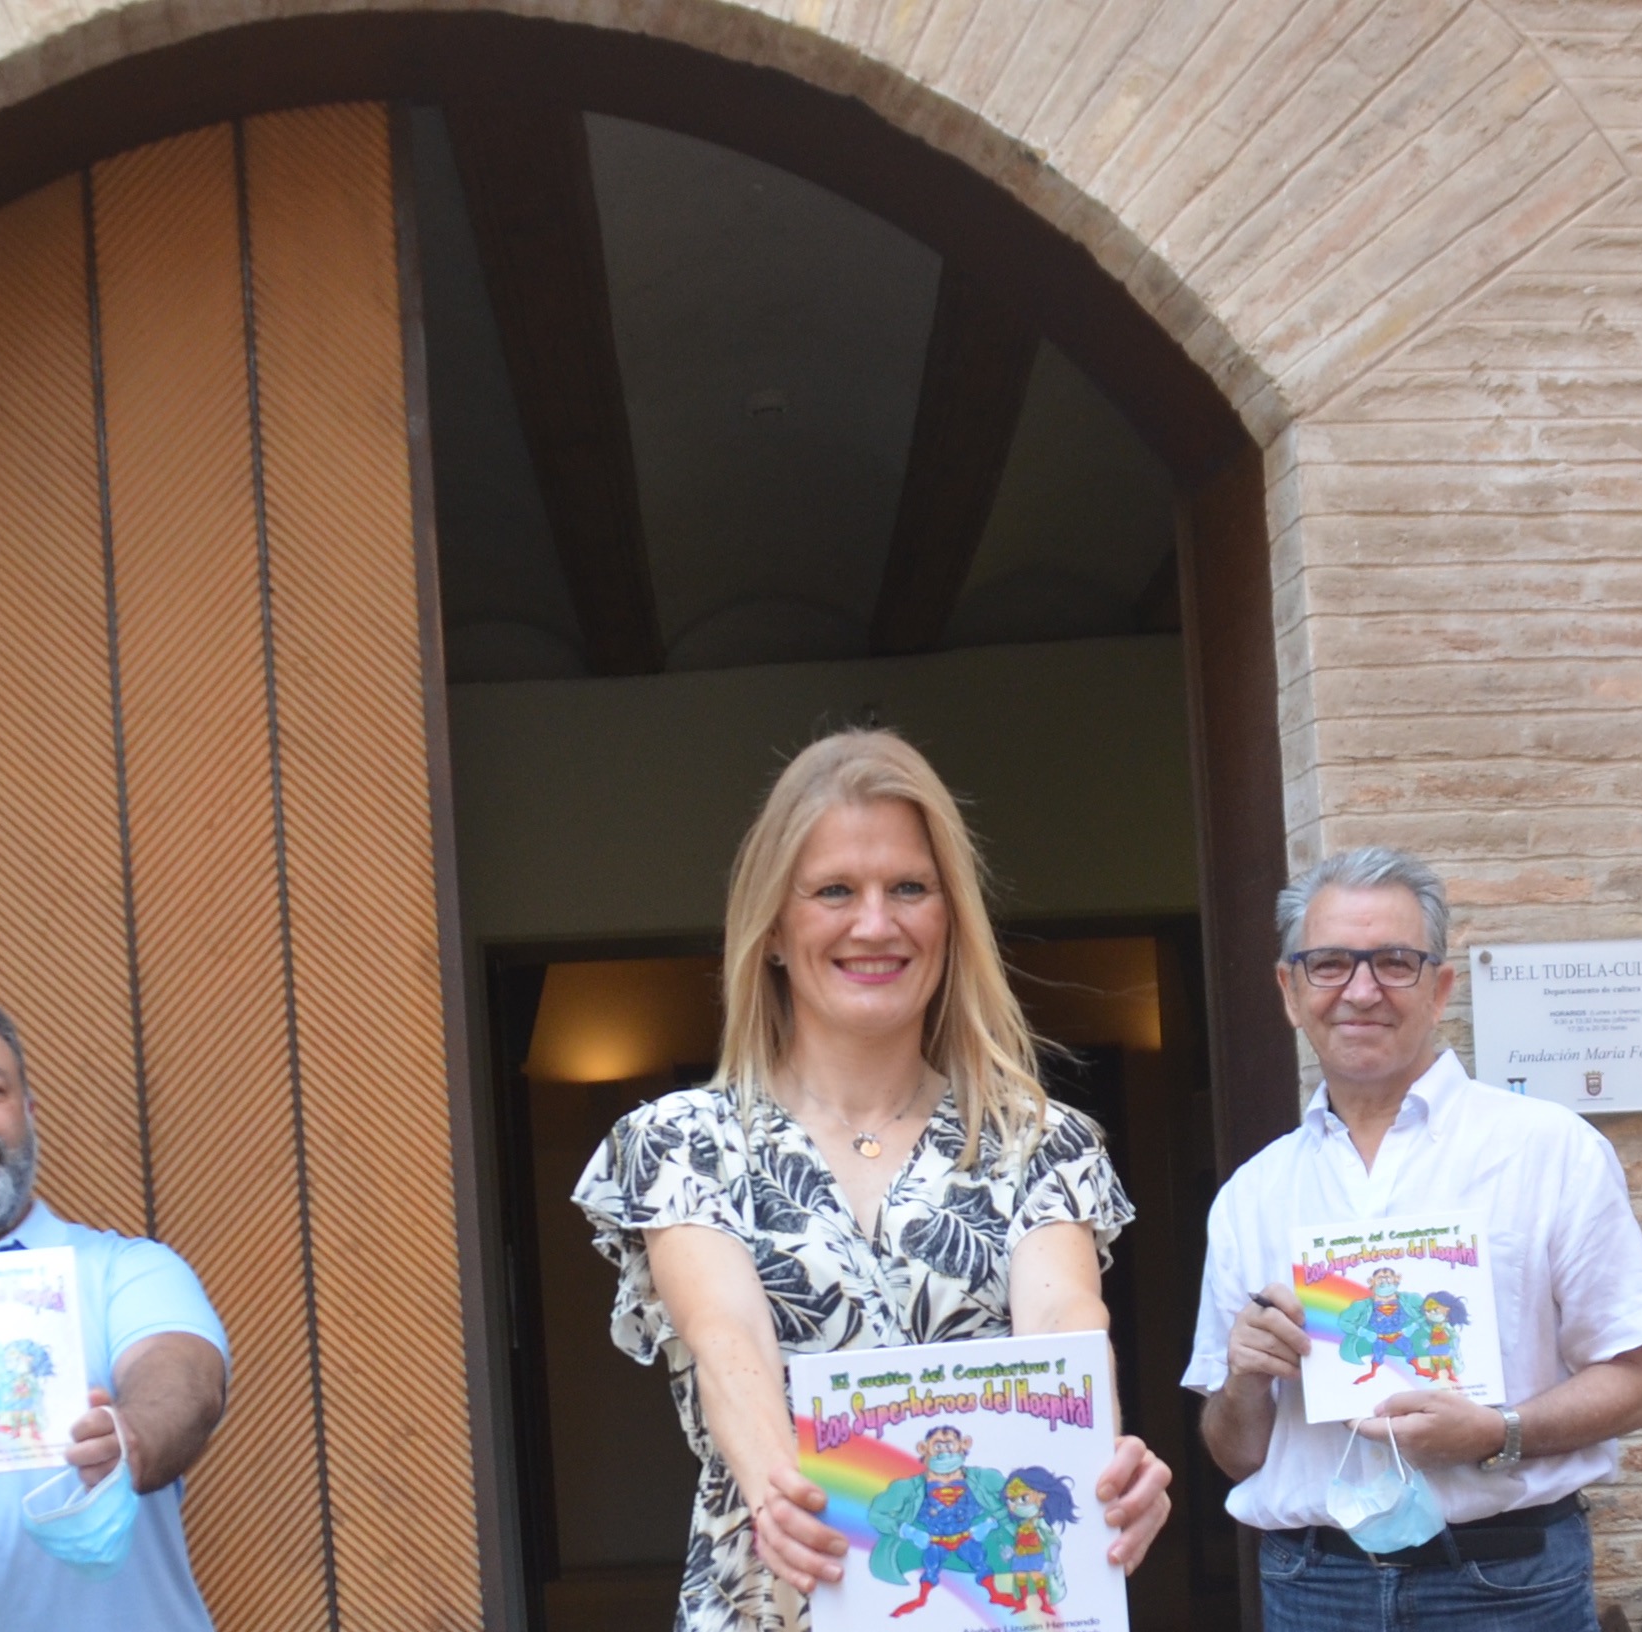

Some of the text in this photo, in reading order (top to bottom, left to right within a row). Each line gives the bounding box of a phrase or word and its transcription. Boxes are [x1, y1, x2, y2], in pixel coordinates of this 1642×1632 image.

[1508, 1047, 1580, 1064] Fundación
[812, 1375, 1095, 1453] Los Superhéroes del Hospital
